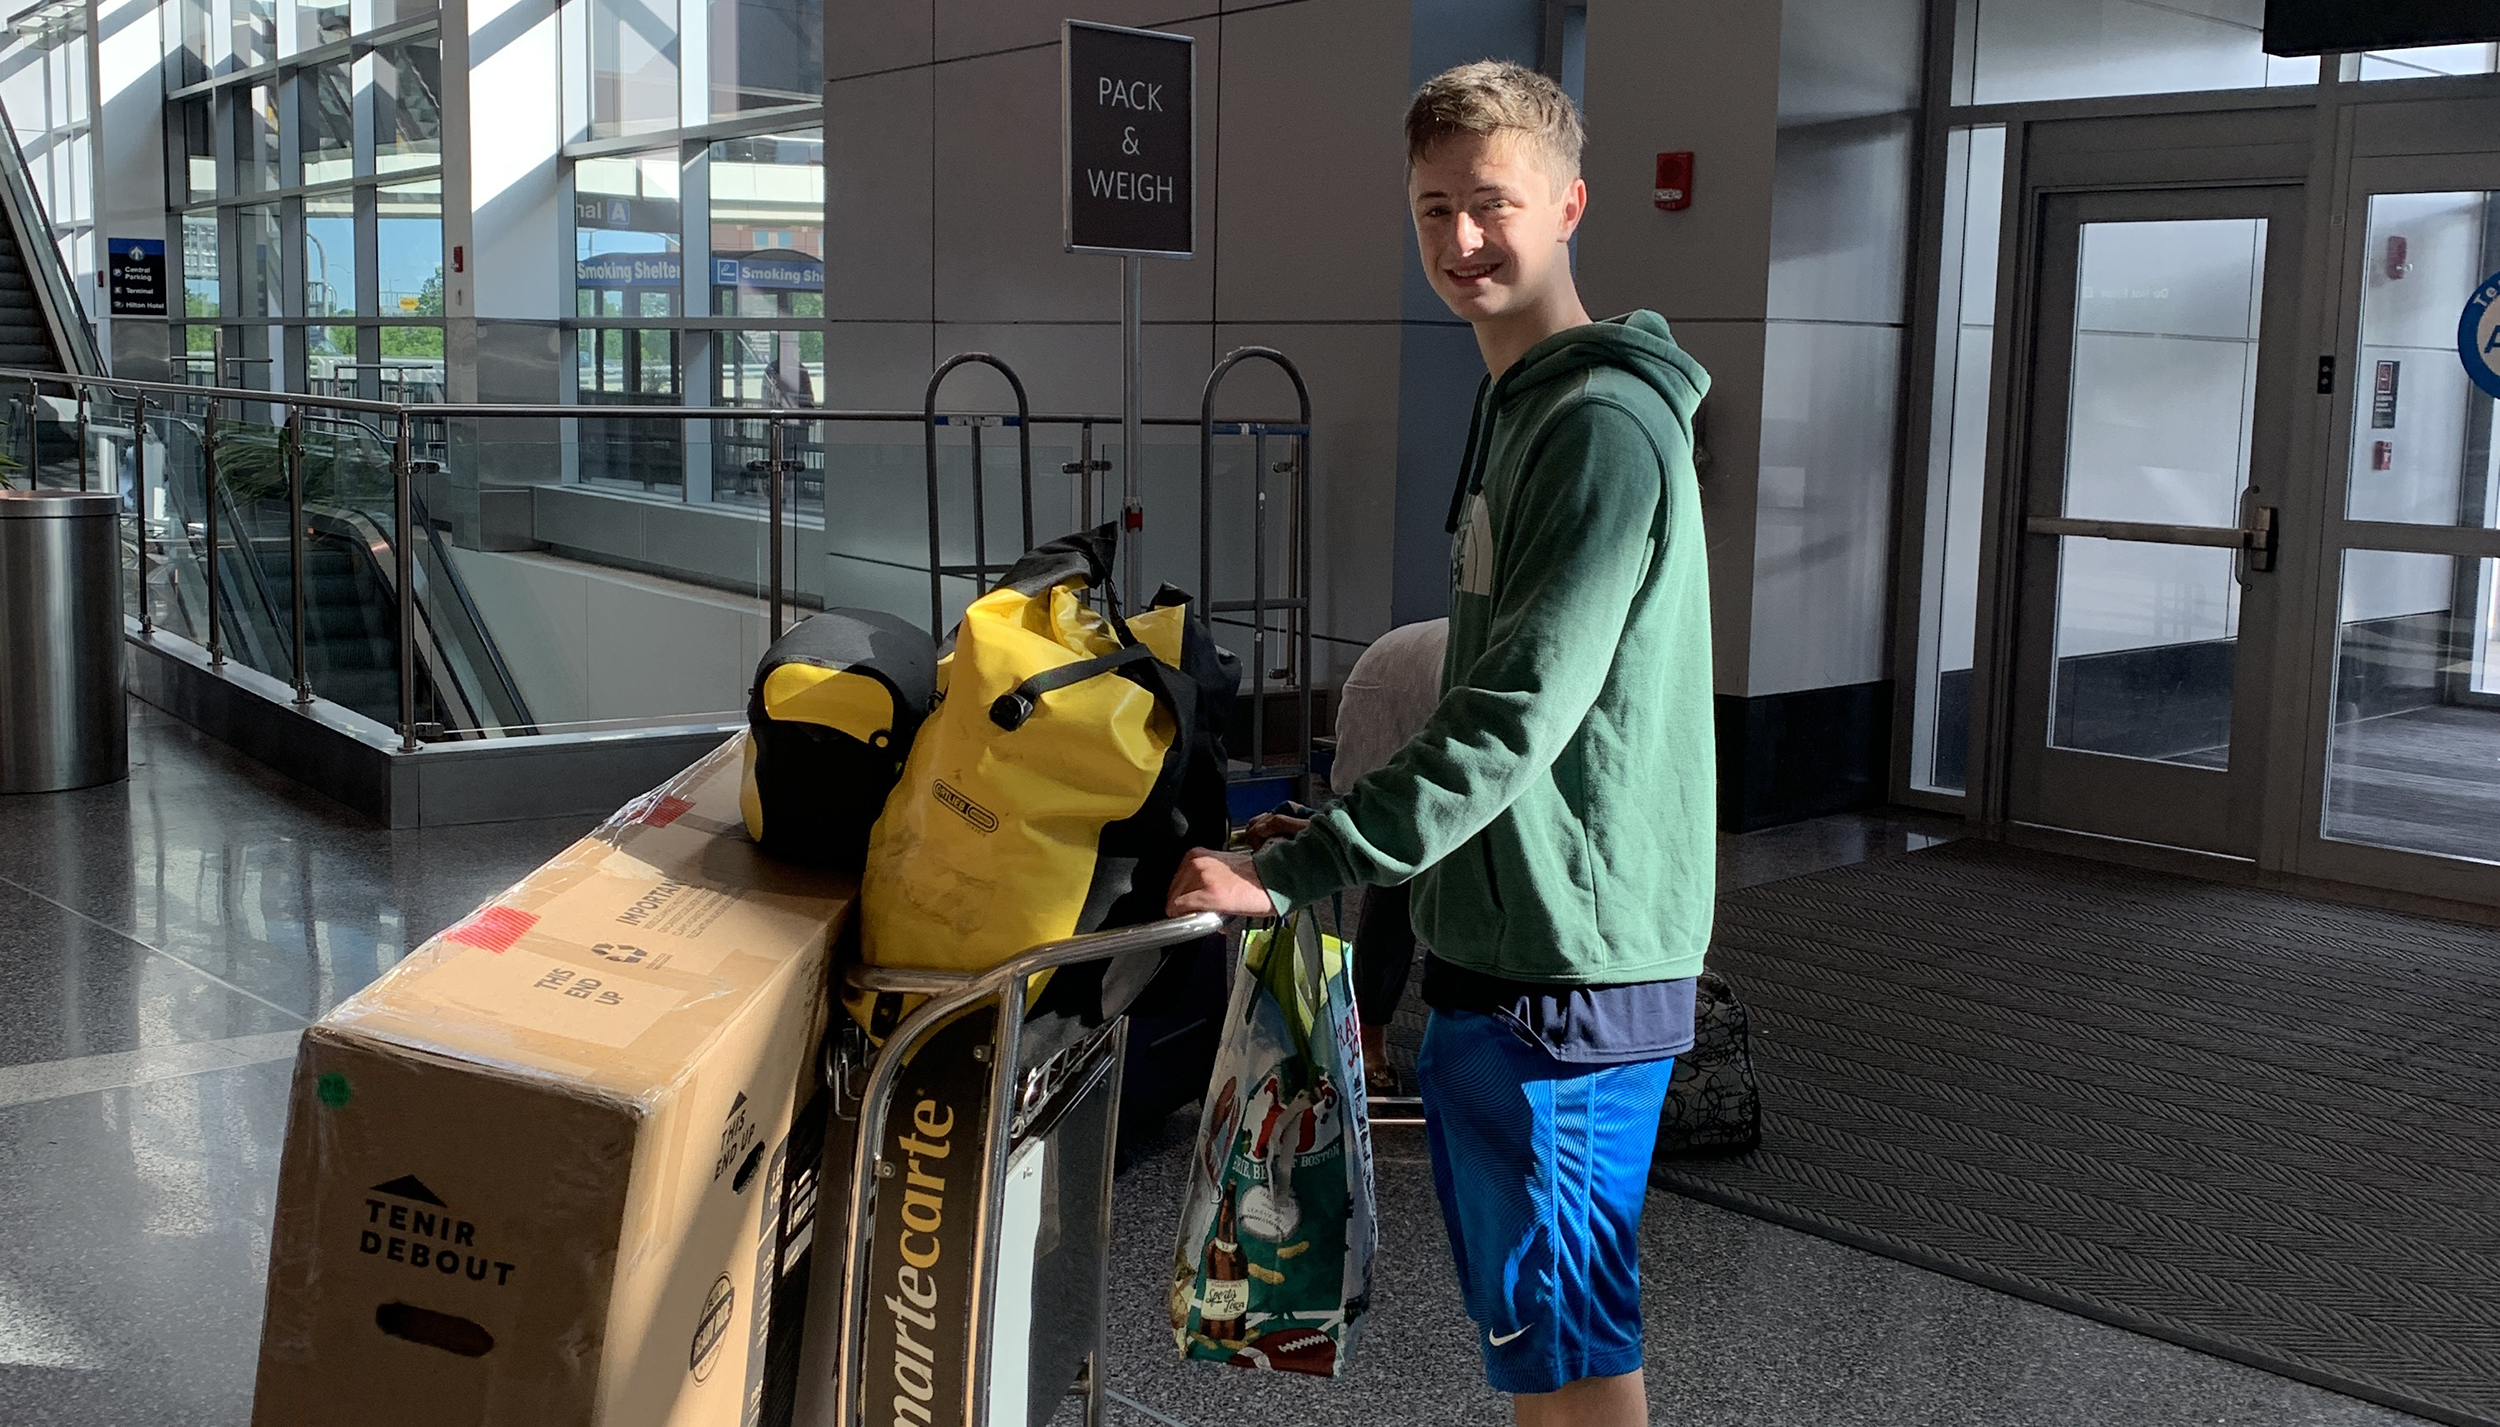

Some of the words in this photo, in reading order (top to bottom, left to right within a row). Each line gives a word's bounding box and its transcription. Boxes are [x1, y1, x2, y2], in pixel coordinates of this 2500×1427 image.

[1099, 77, 1163, 112] PACK
[1122, 126, 1140, 155] &
[1087, 169, 1173, 203] WEIGH
[611, 203, 626, 221] A
[577, 262, 632, 283] Smoking
[742, 266, 801, 284] Smoking
[533, 967, 577, 991] THIS
[563, 978, 603, 1000] END
[594, 990, 624, 1006] UP
[721, 1109, 746, 1151] THIS
[714, 1142, 738, 1182] END
[740, 1122, 755, 1152] UP
[1301, 1143, 1340, 1168] BOSTON
[365, 1199, 475, 1247] TENIR
[360, 1230, 515, 1286] DEBOUT
